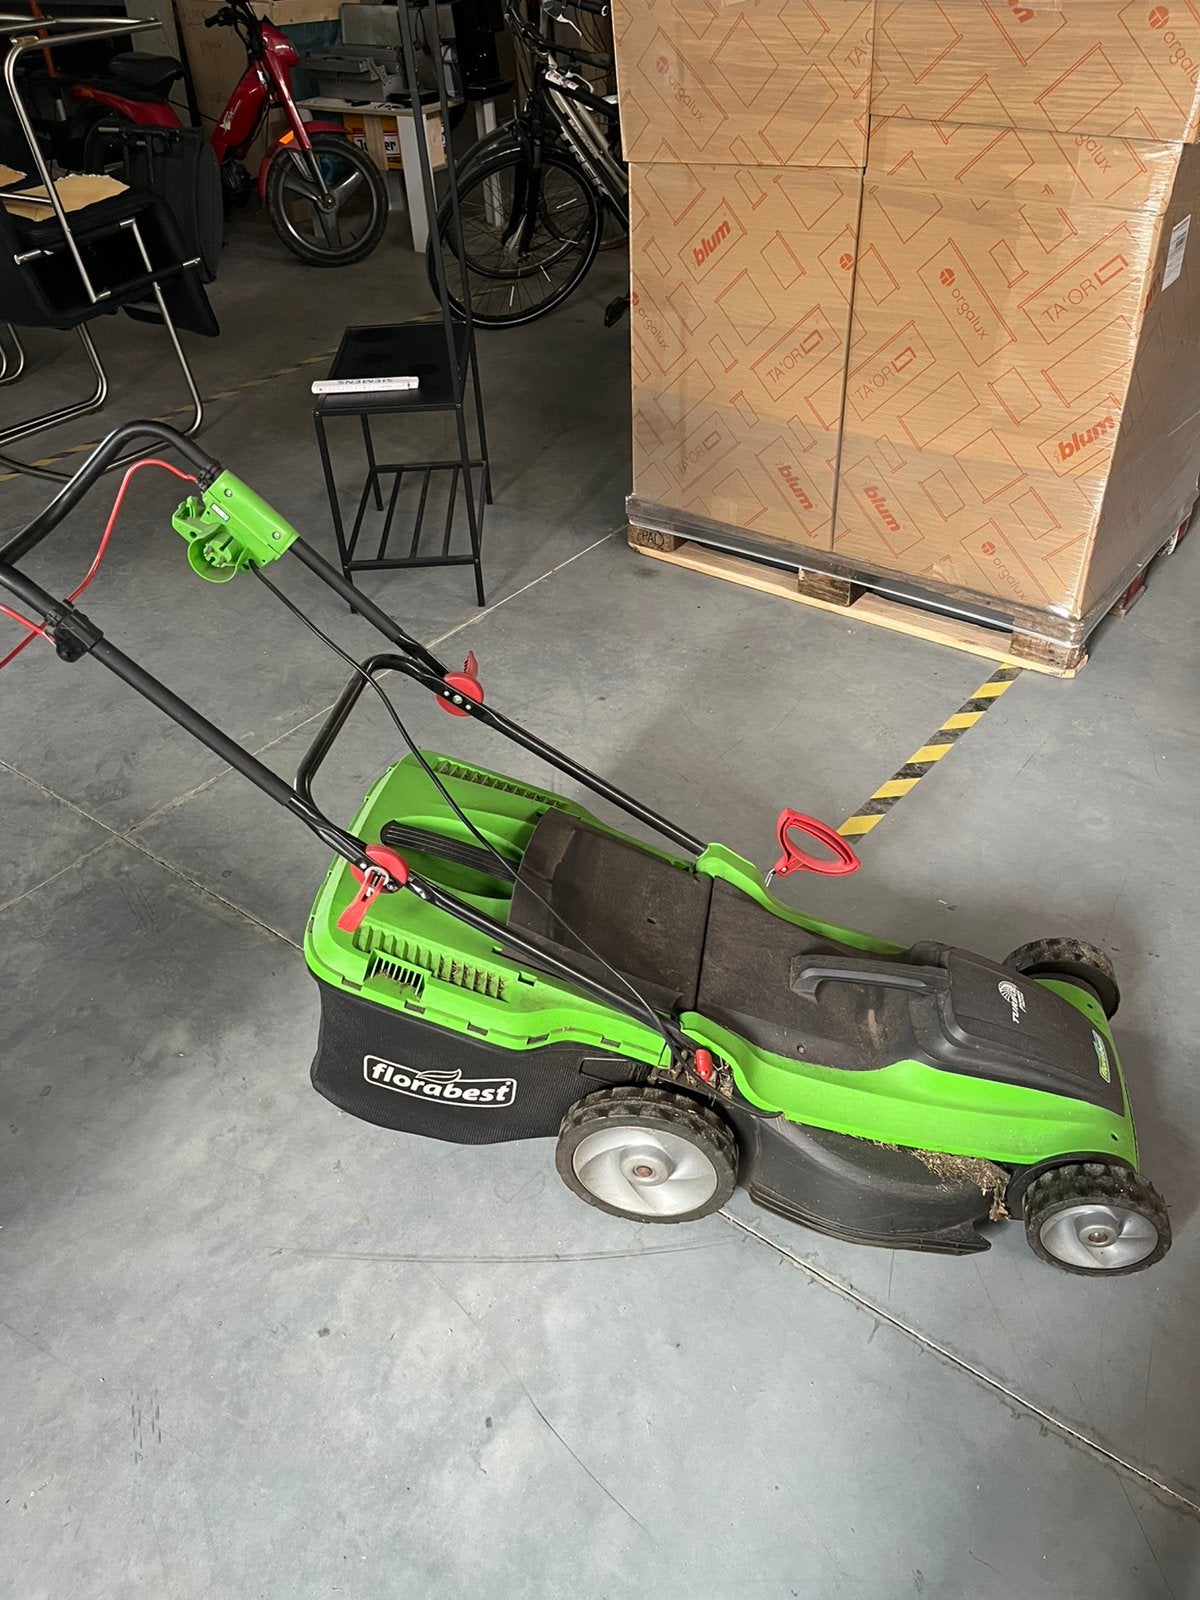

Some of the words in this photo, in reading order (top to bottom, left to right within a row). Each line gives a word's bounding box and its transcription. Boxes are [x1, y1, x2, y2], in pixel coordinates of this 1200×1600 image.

[1163, 31, 1200, 86] orgalu
[668, 76, 704, 122] orgalux
[560, 126, 609, 197] TREK
[693, 220, 731, 267] blum
[638, 308, 670, 351] orgalux
[951, 288, 990, 341] orgalux
[1058, 413, 1115, 462] blum
[778, 464, 813, 511] blum
[863, 486, 903, 533] blum
[992, 556, 1028, 601] orgalux
[372, 1063, 511, 1102] florabest
